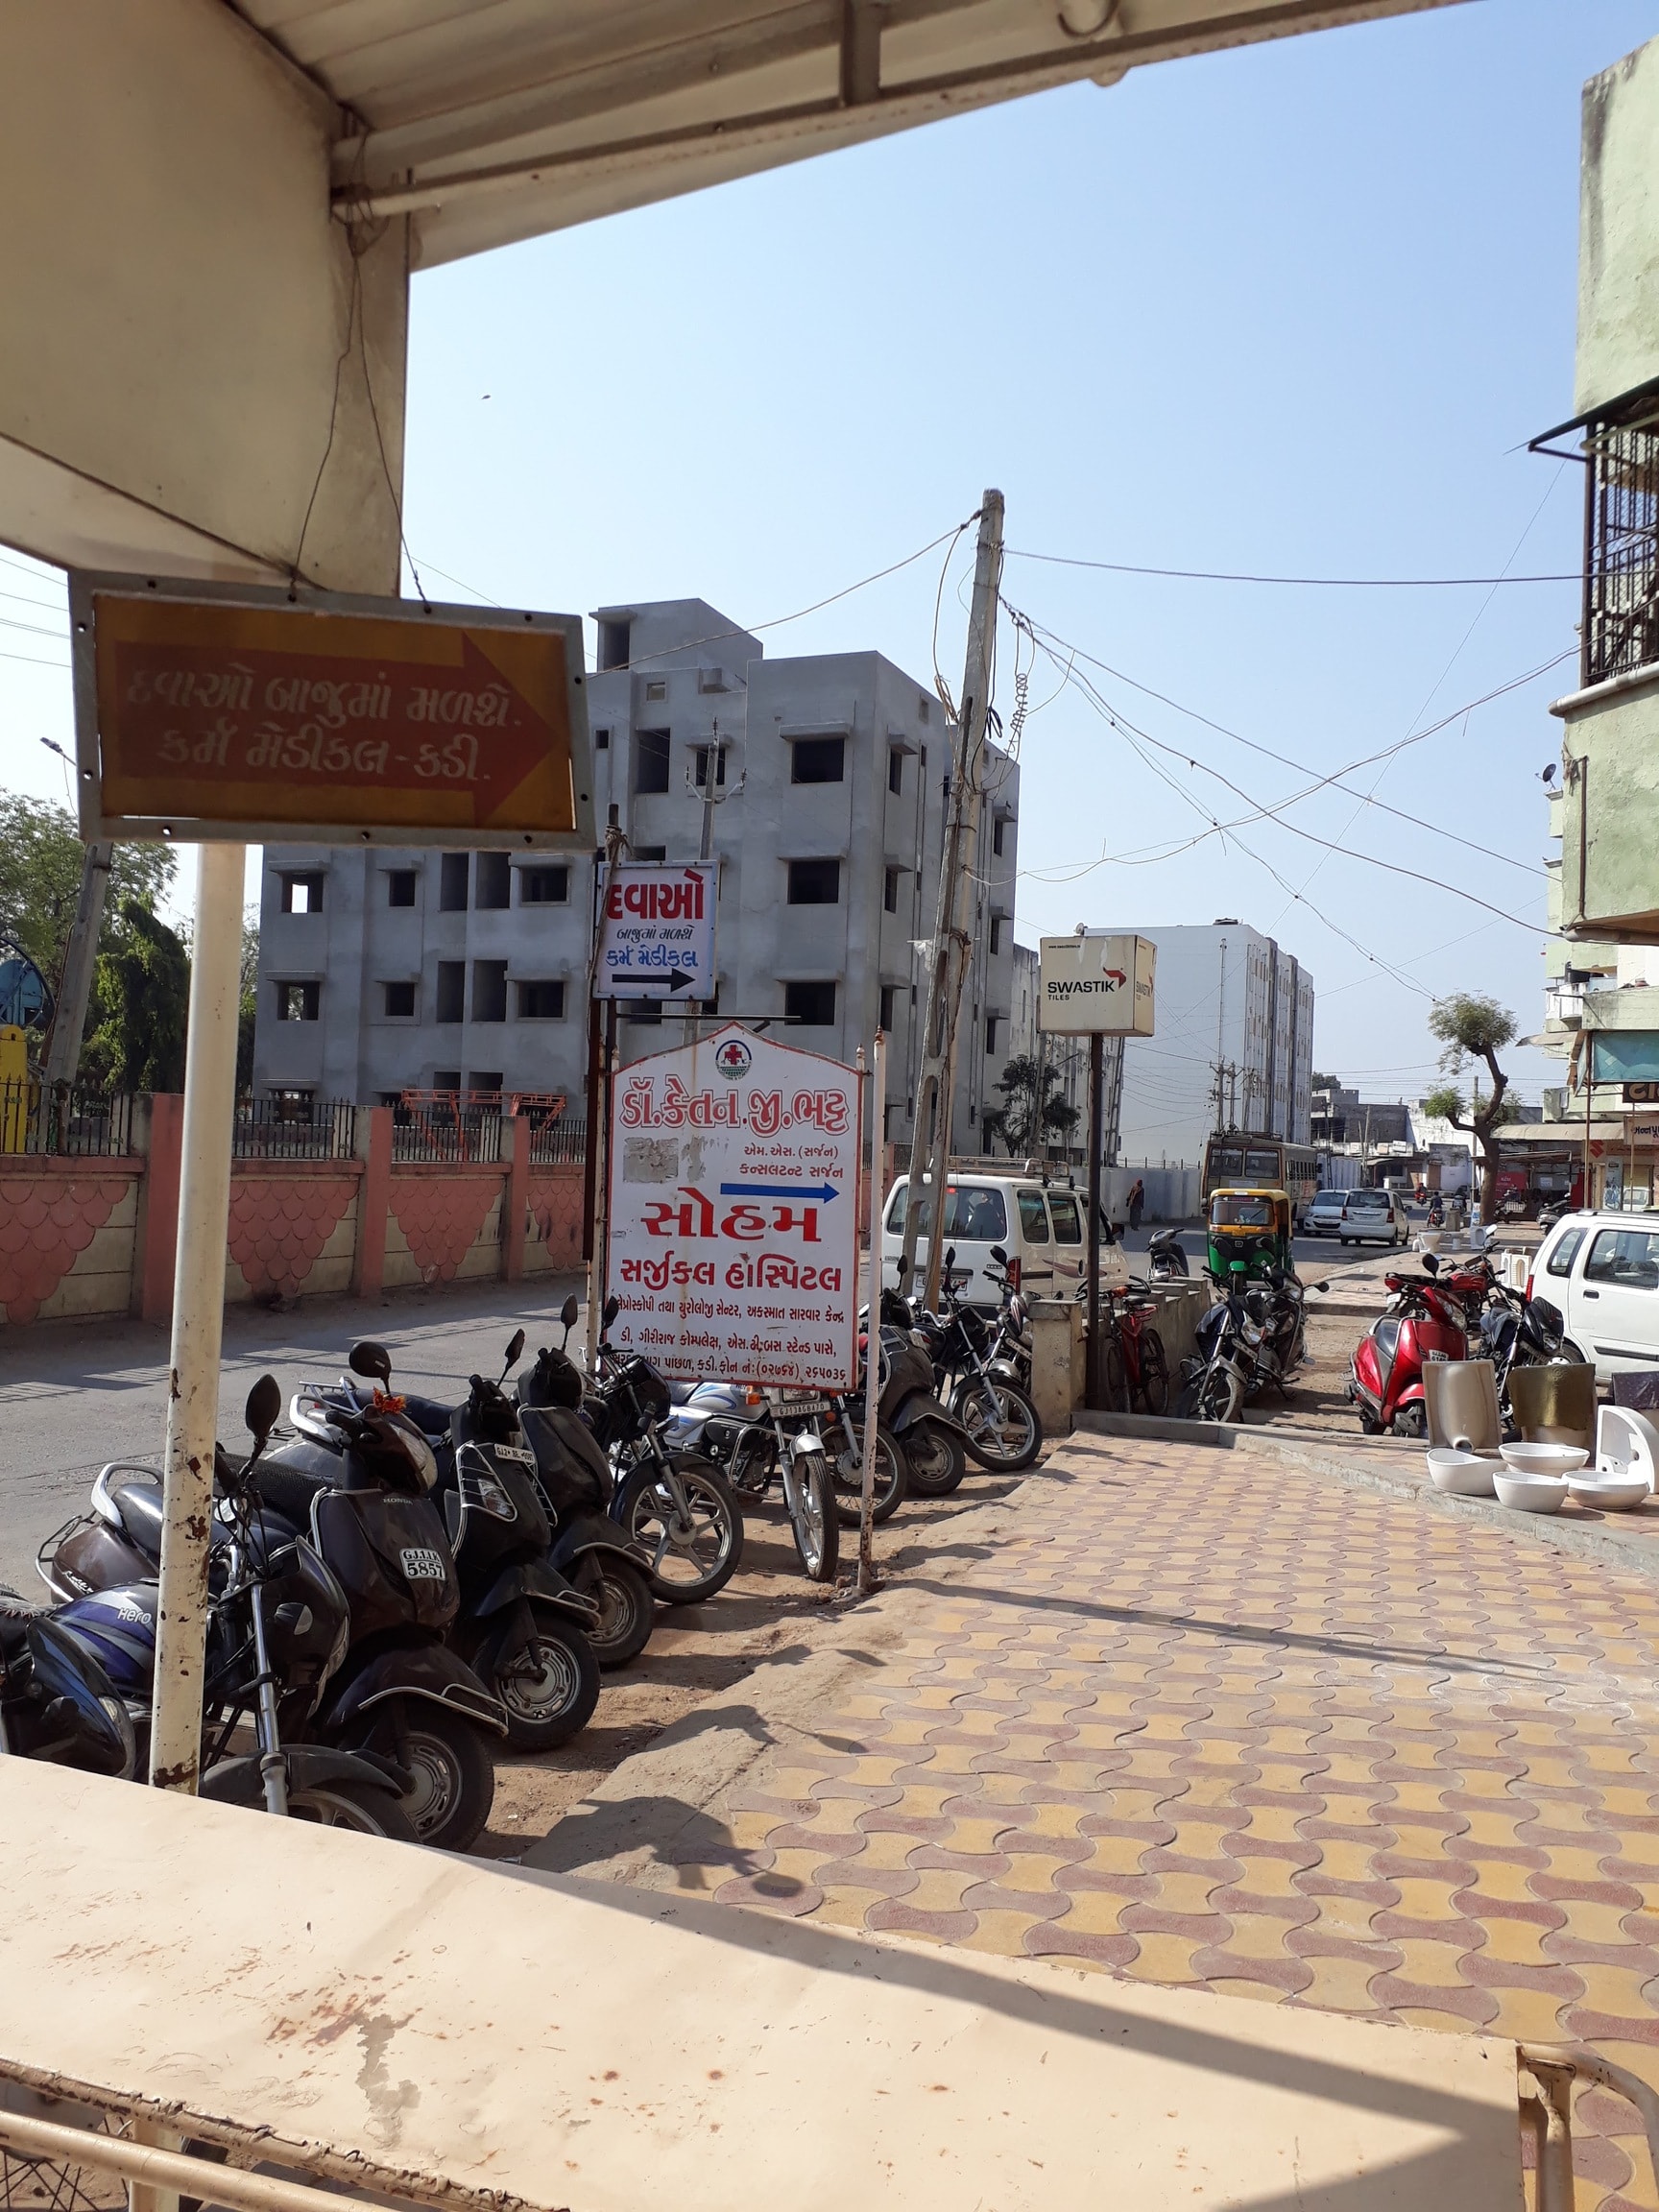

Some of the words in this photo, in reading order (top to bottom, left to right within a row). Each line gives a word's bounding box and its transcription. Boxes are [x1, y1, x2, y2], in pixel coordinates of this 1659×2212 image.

[127, 661, 256, 711] દવાઓ
[265, 671, 392, 729] બાજુમાં
[607, 868, 704, 920] દવાઓ
[616, 925, 657, 943] બાજુમાં
[659, 924, 695, 940] મળશે
[637, 944, 699, 968] મેડીકલ
[1047, 980, 1115, 994] SWASTIK
[809, 1163, 844, 1179] સર્જન
[640, 1187, 822, 1242] સોહમ
[620, 1250, 715, 1291] સર્જીકલ
[658, 1302, 675, 1313] તથા
[789, 1308, 821, 1322] સારવાર
[407, 1561, 443, 1578] 5857
